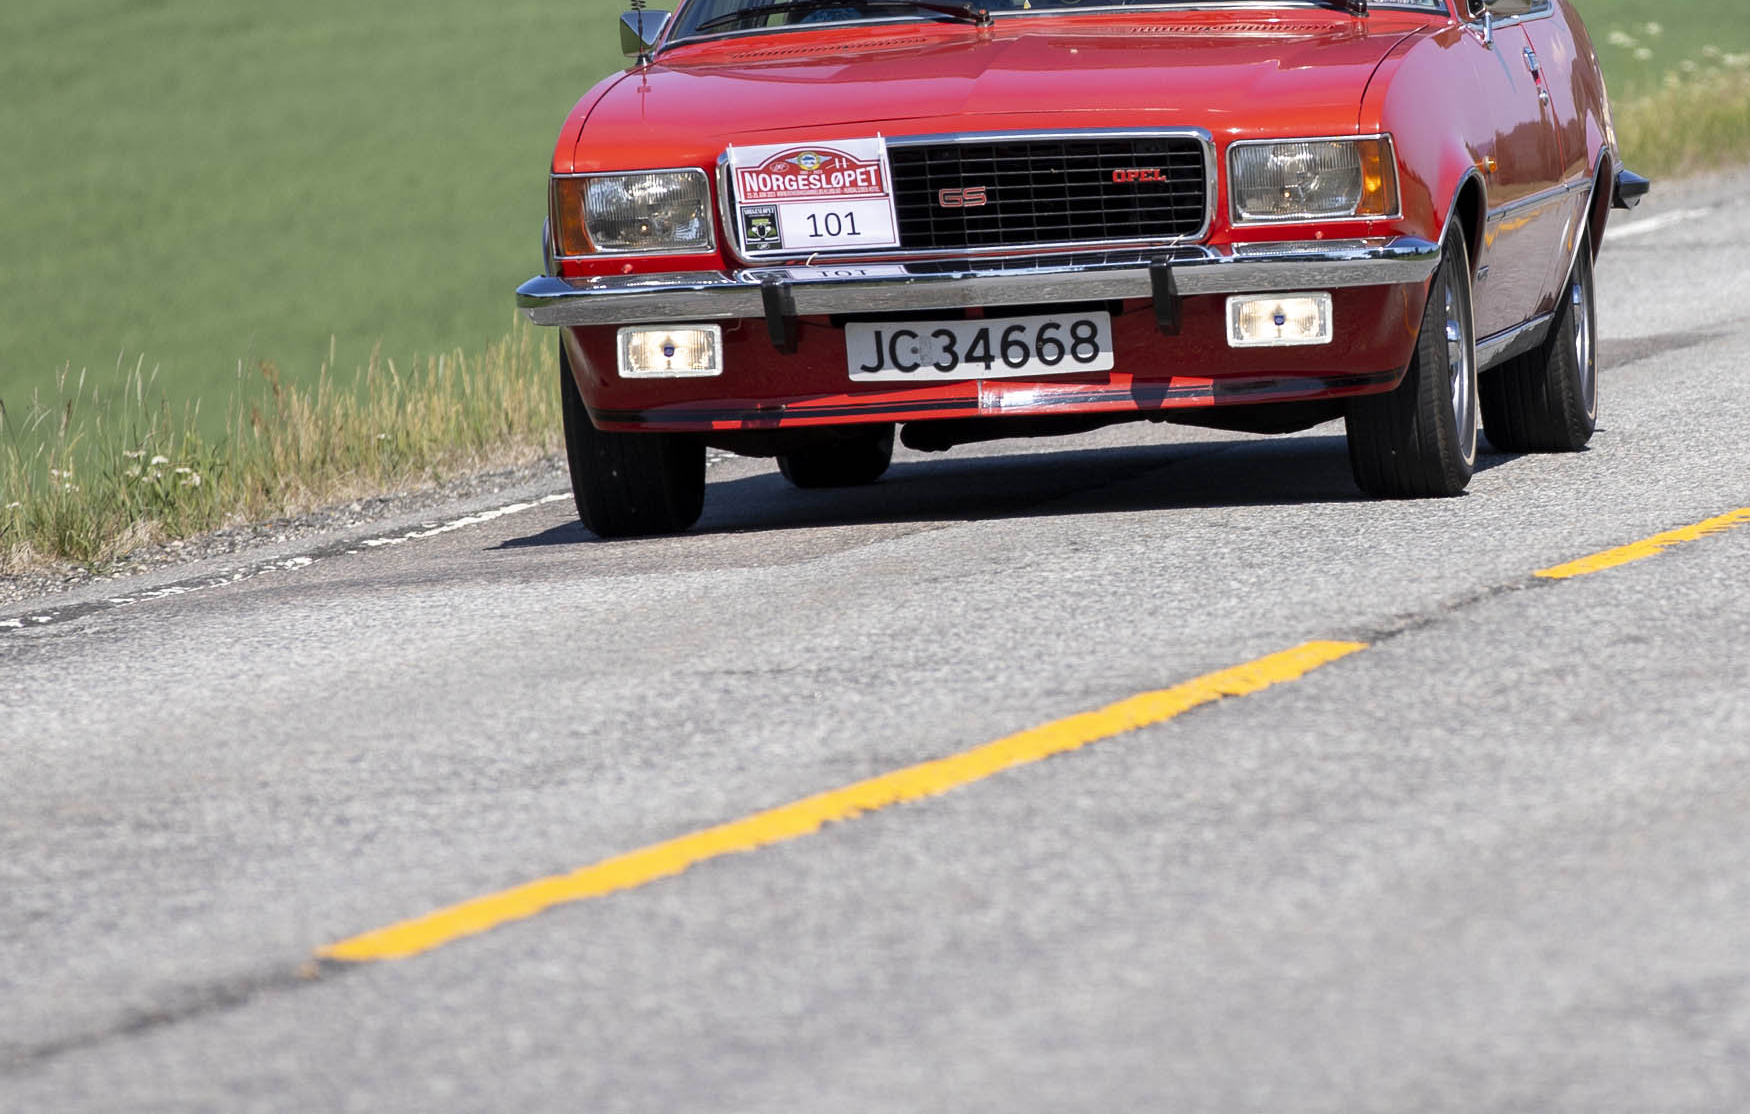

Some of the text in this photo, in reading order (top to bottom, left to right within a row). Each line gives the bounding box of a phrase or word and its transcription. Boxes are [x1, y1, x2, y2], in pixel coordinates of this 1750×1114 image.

[744, 166, 878, 192] NORGESLØPET
[1112, 168, 1167, 183] OPEL
[938, 186, 987, 208] GS
[806, 211, 861, 238] 101
